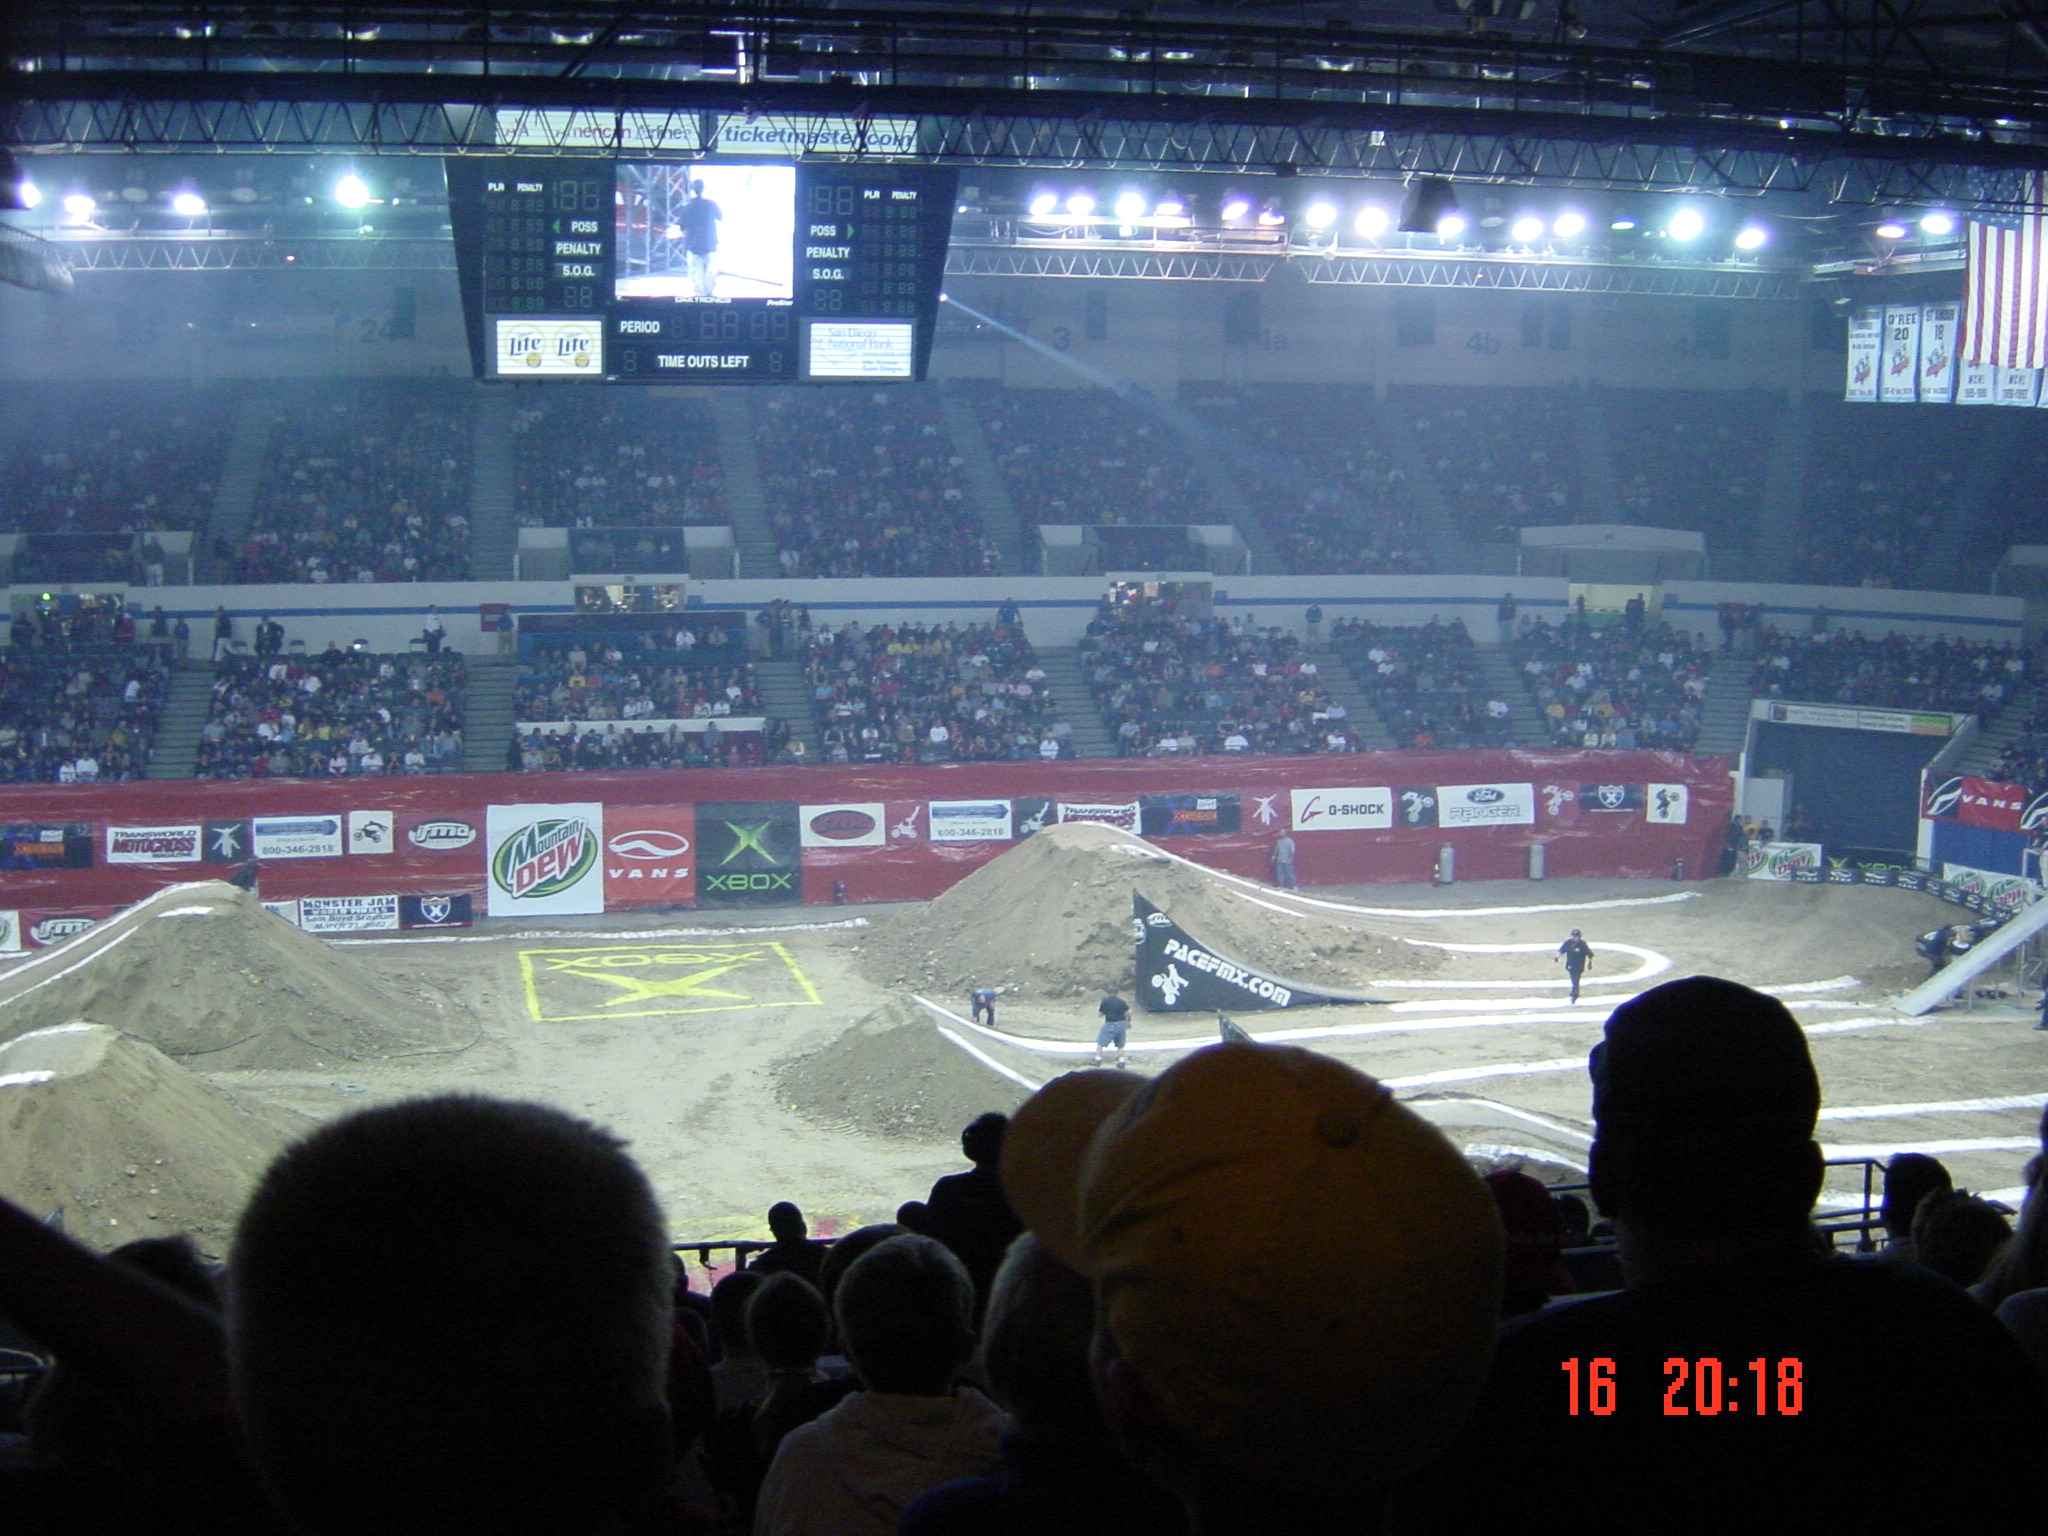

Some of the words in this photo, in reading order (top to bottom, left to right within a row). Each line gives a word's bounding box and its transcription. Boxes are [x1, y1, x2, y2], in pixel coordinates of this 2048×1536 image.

[725, 126, 913, 147] ticketmastercom
[488, 182, 505, 192] PLR
[864, 190, 880, 199] PLR
[571, 221, 598, 232] POSS
[811, 225, 836, 236] POSS
[556, 243, 601, 255] PENALTY
[806, 247, 850, 258] PENALTY
[562, 265, 595, 276] S.O.G.
[813, 268, 844, 279] S.O.G.
[620, 320, 660, 334] PERIOD
[1934, 324, 1944, 341] 18
[1052, 327, 1072, 352] 3
[1894, 327, 1909, 341] 20
[510, 337, 542, 356] Lite
[558, 337, 590, 356] Lite
[828, 338, 867, 349] National
[658, 355, 685, 367] TIME
[687, 355, 719, 368] OUTS
[721, 355, 749, 368] LEFT
[1962, 794, 2023, 810] VANS
[1328, 803, 1385, 816] G-SHOCK
[1449, 804, 1521, 822] RANGER
[114, 830, 197, 838] TRANSWORLD
[609, 867, 689, 879] VANS
[706, 873, 792, 891] XBOX
[303, 898, 363, 909] MONSTER
[367, 897, 395, 907] JAM
[1164, 938, 1291, 1007] PACEFMX.COM
